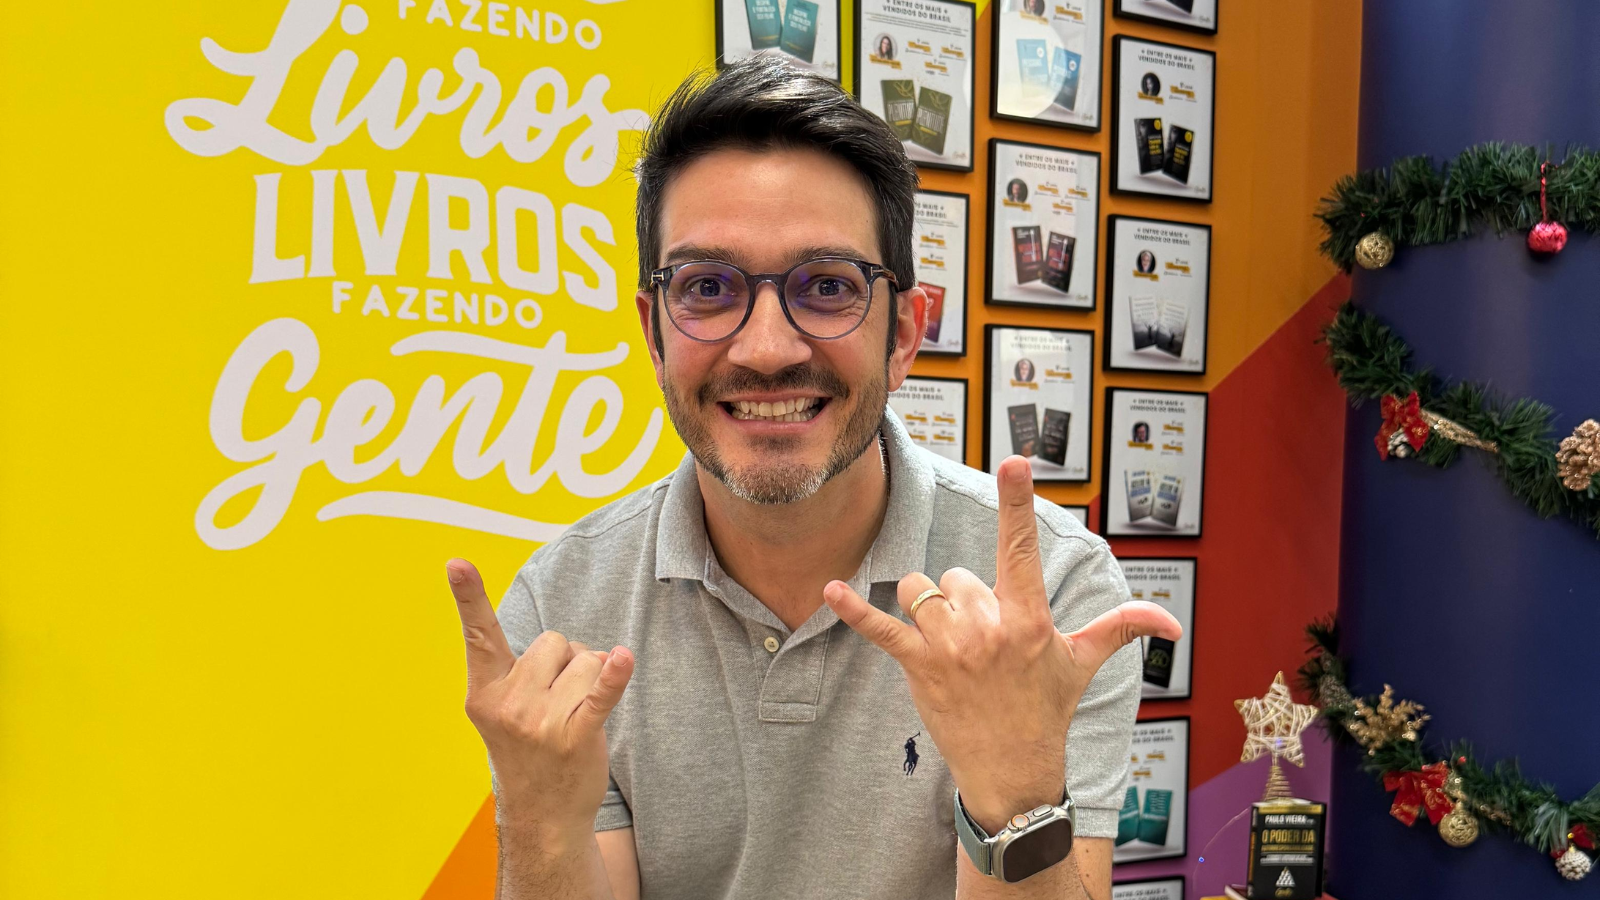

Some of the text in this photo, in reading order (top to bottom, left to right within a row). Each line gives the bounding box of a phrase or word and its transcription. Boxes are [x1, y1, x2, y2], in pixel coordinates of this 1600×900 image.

[398, 0, 602, 50] FAZENDO
[882, 5, 951, 23] VENDIDOS DO BRASIL
[925, 5, 942, 13] MAIS
[164, 0, 650, 187] Livros
[248, 168, 619, 312] LIVROS
[332, 281, 542, 329] FAZENDO
[194, 317, 663, 551] Gente
[1262, 829, 1315, 844] O PODER DA
[1264, 814, 1307, 824] PAULO VIEIRA
